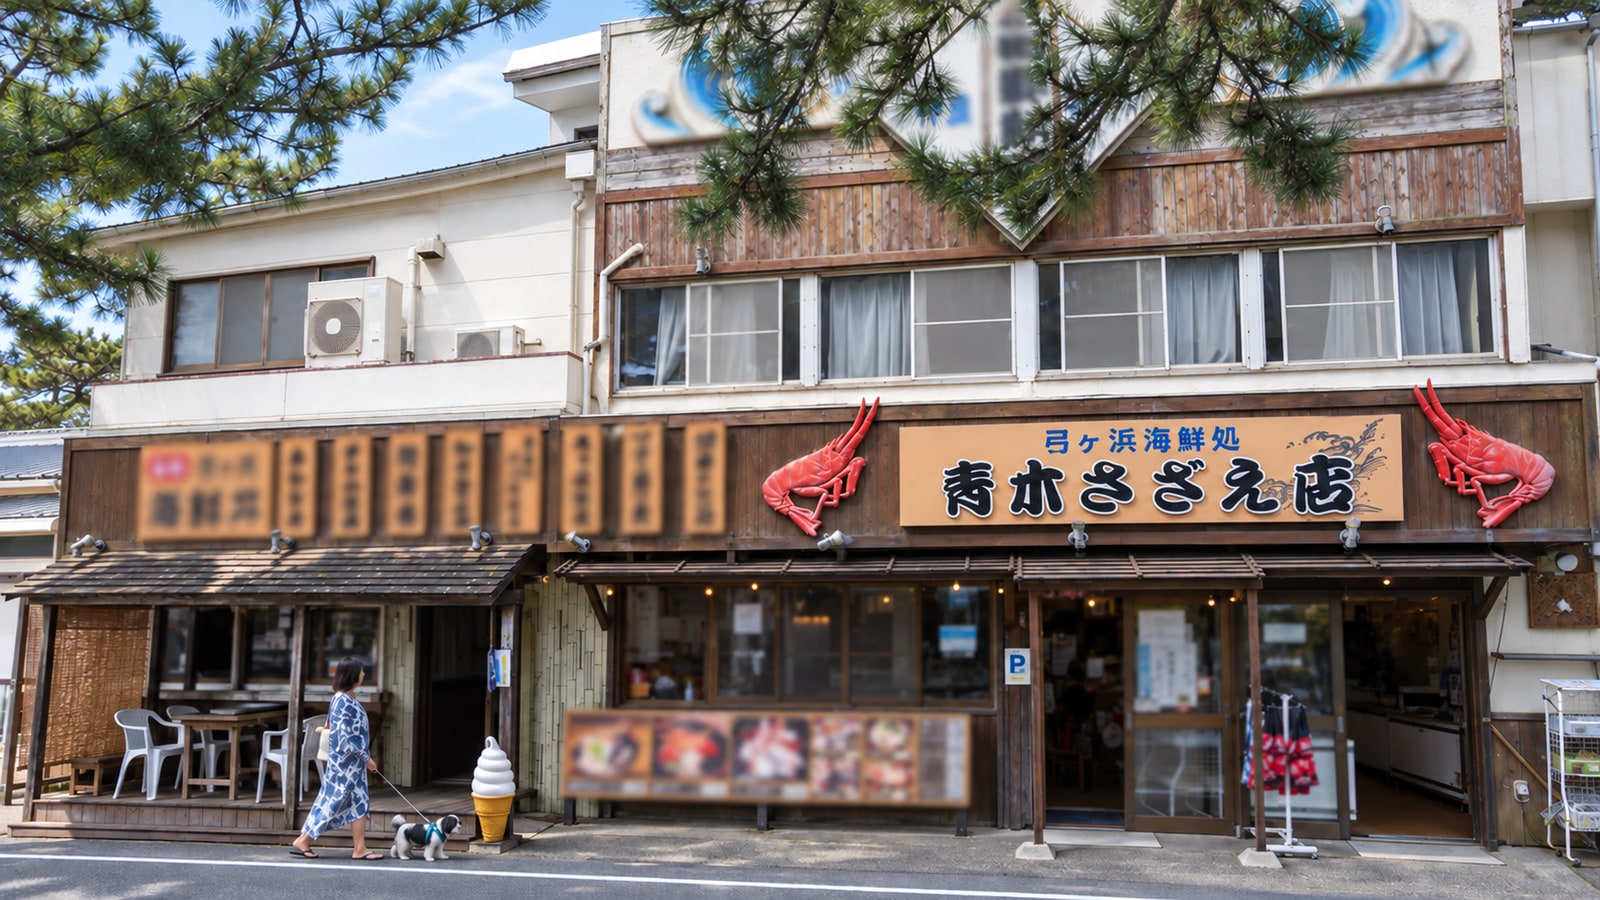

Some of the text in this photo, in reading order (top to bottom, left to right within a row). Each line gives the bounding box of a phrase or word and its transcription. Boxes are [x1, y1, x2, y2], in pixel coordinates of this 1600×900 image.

[942, 453, 1356, 519] 青木さざえ店
[1010, 654, 1026, 674] P
